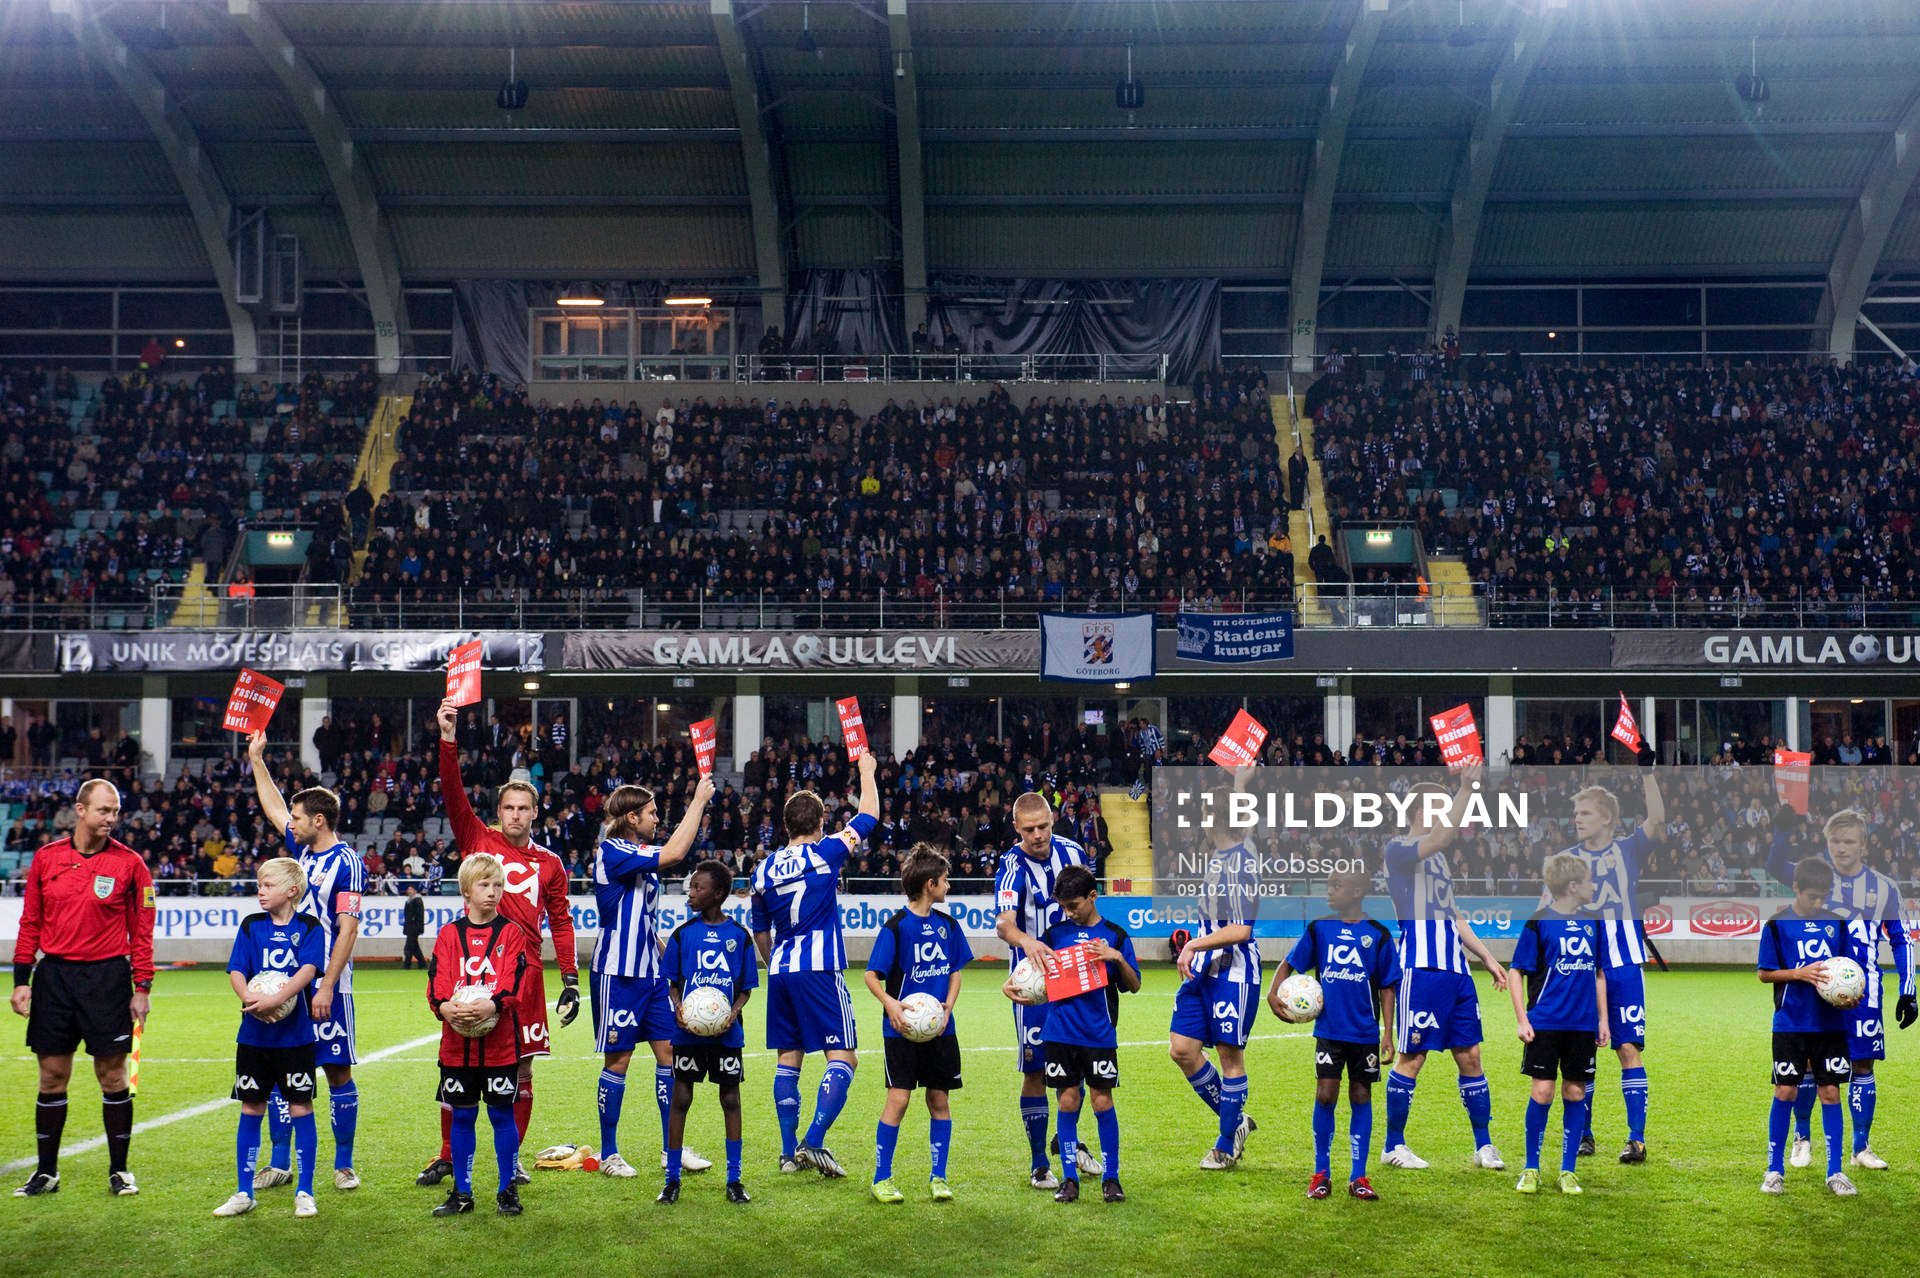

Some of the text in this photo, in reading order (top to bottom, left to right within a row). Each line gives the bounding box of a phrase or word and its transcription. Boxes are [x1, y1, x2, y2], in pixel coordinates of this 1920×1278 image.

[1212, 615, 1283, 627] IFK GÖTEBORG
[1213, 627, 1286, 643] Stadens
[113, 642, 176, 662] UNIK
[187, 633, 344, 662] MÖTESPLATS
[371, 640, 491, 663] CENTR
[517, 637, 544, 666] 12
[653, 636, 955, 664] GAMLA ULLEVI
[1213, 640, 1282, 658] kungar
[1704, 635, 1847, 664] GAMLA
[239, 671, 252, 685] Ge
[1075, 665, 1121, 676] GÖTEBORG
[229, 699, 248, 713] rött
[233, 686, 277, 710] rasismen
[1432, 718, 1446, 731] Ge
[1437, 722, 1477, 745] rasismen
[1443, 743, 1463, 759] rött
[774, 859, 802, 878] KIA
[776, 880, 807, 928] 7
[923, 923, 933, 931] ICA
[1566, 917, 1578, 926] ICA
[1701, 910, 1748, 926] scan
[706, 930, 718, 938] ICA
[1077, 931, 1090, 939] ICA
[1341, 928, 1353, 936] ICA
[914, 941, 948, 963] ICA
[1327, 943, 1364, 968] ICA
[1559, 936, 1593, 957] ICA
[1797, 938, 1833, 959] ICA
[262, 948, 299, 969] ICA
[459, 955, 497, 977] ICA
[696, 949, 730, 972] ICA
[1059, 949, 1073, 970] rött
[911, 963, 951, 984] Kundkort
[1074, 945, 1091, 992] rasismen
[607, 1009, 639, 1027] ICA
[1213, 1001, 1239, 1019] ICA
[1620, 1005, 1645, 1023] ICA
[1220, 1021, 1233, 1034] 13
[1408, 1010, 1440, 1029] ICA
[1856, 1019, 1884, 1038] ICA
[313, 1020, 347, 1042] ICA
[522, 1021, 550, 1044] ICA
[825, 1034, 840, 1044] ICA
[1023, 1025, 1043, 1046] IC
[1633, 1025, 1645, 1037] 16
[331, 1043, 341, 1056] 9
[1872, 1040, 1884, 1052] 21
[675, 1055, 699, 1072] ICA
[719, 1056, 741, 1072] ICA
[1092, 1060, 1117, 1076] ICA
[1774, 1061, 1798, 1076] ICA
[1825, 1056, 1850, 1072] ICA
[235, 1074, 260, 1090] ICA
[286, 1072, 313, 1088] ICA
[487, 1076, 515, 1093] ICA
[1853, 1086, 1862, 1112] SKF
[275, 1096, 291, 1124] SKF
